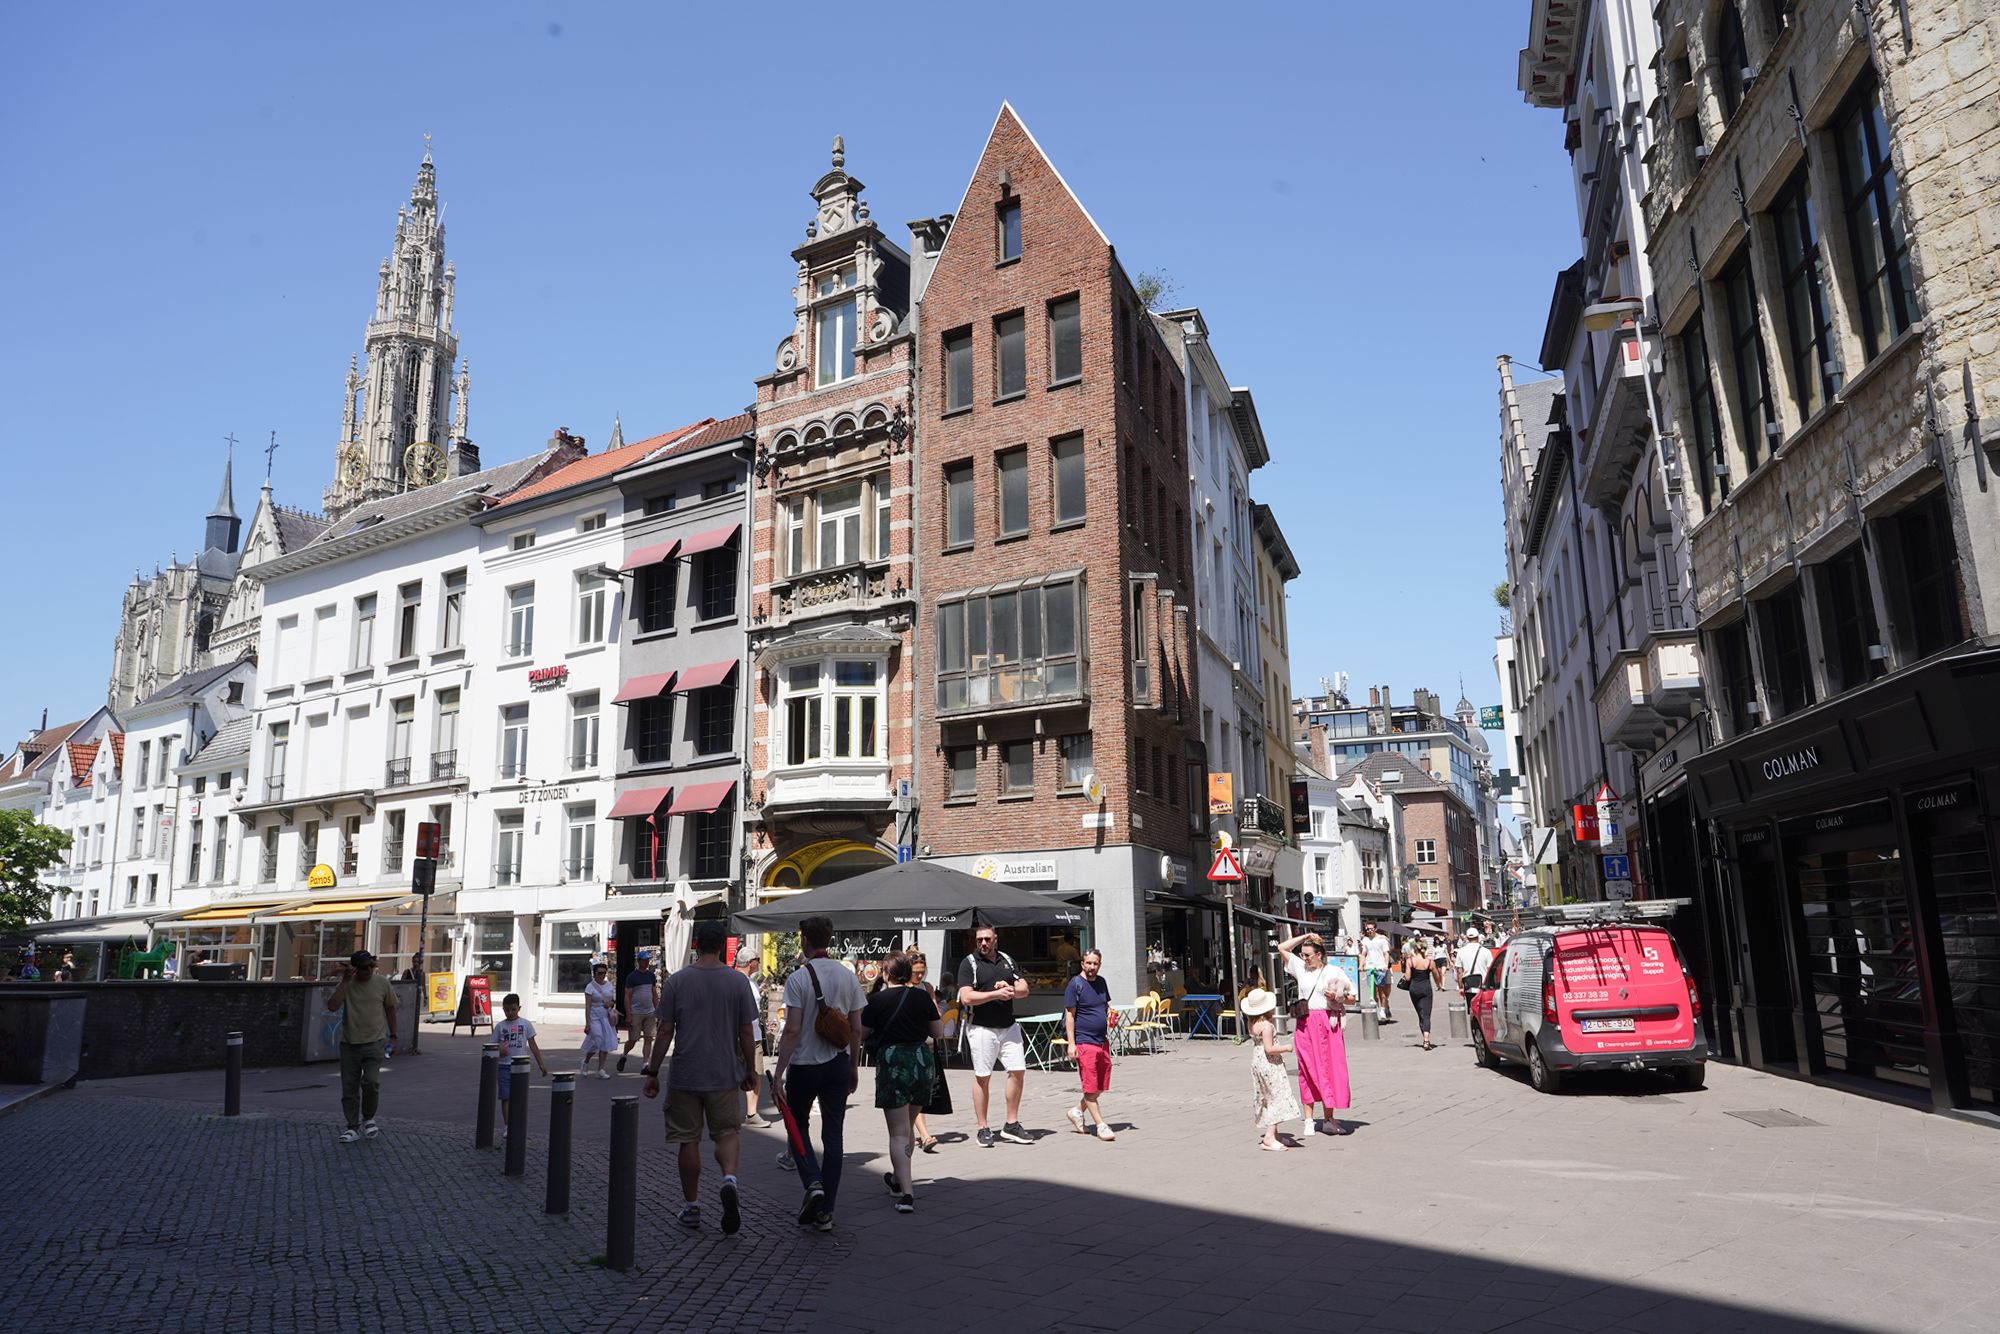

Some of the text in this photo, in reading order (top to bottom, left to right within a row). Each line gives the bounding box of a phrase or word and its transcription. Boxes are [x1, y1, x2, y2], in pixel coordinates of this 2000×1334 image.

[528, 665, 567, 682] PRIMUS
[1763, 746, 1819, 781] COLMAN
[519, 787, 569, 803] DE 7 ZONDEN
[1917, 792, 1958, 810] COLMAN
[1815, 815, 1844, 830] COLMAN
[1742, 831, 1765, 844] COLMAN
[1004, 863, 1054, 875] Australian
[840, 937, 866, 954] Street
[866, 935, 898, 954] Food
[1574, 991, 1587, 999] 337
[1588, 991, 1598, 999] 38
[1599, 990, 1609, 998] 39
